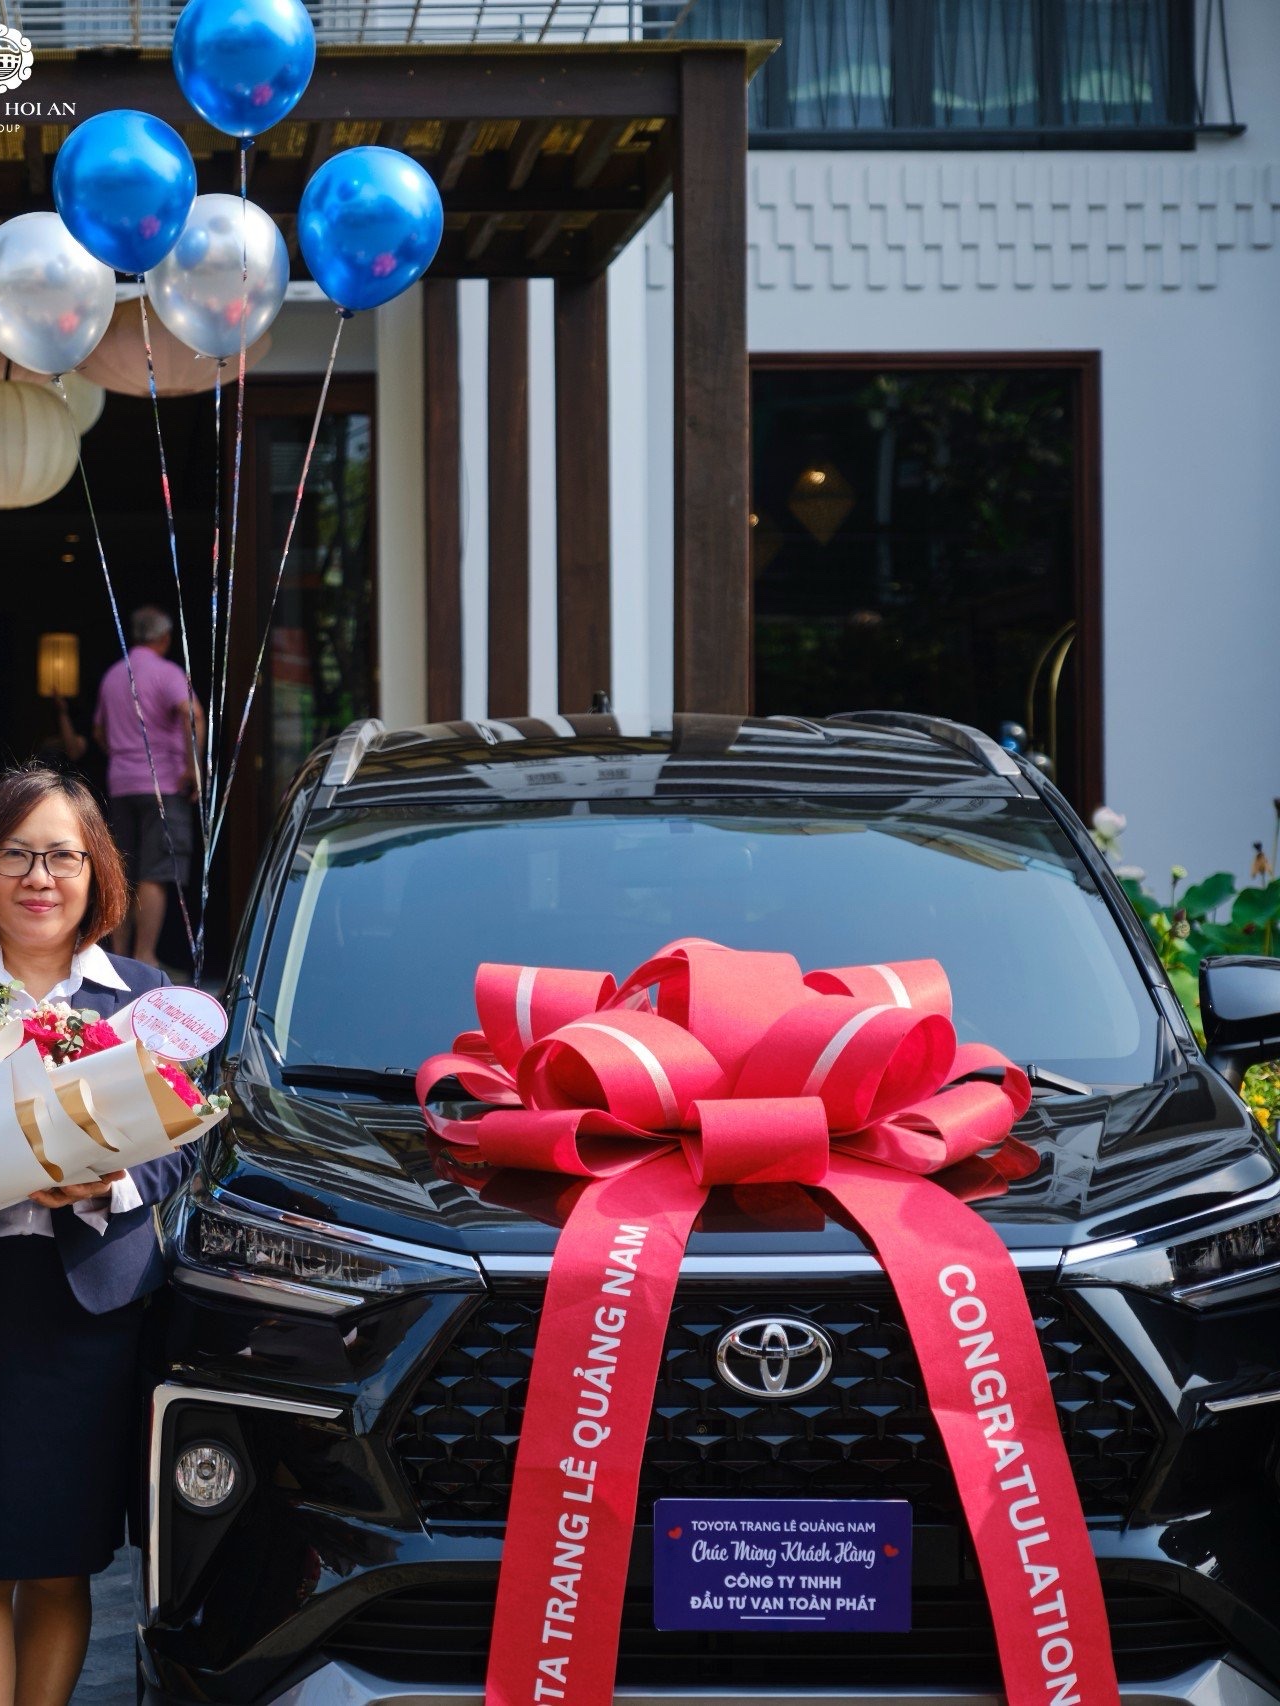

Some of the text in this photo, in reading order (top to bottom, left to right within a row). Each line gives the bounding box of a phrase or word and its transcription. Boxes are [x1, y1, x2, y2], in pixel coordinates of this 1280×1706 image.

[533, 1224, 650, 1706] TA TRANG LÊ QUẢNG NAM
[691, 1519, 876, 1534] TOYOTA TRANG LÊ QUẢNG NAM
[691, 1539, 876, 1569] Chúc Mừng Khách Hàng
[724, 1572, 842, 1589] CÔNG TY TNHH
[690, 1590, 877, 1614] ĐẦU TƯ VẠN TOÀN PHÁT
